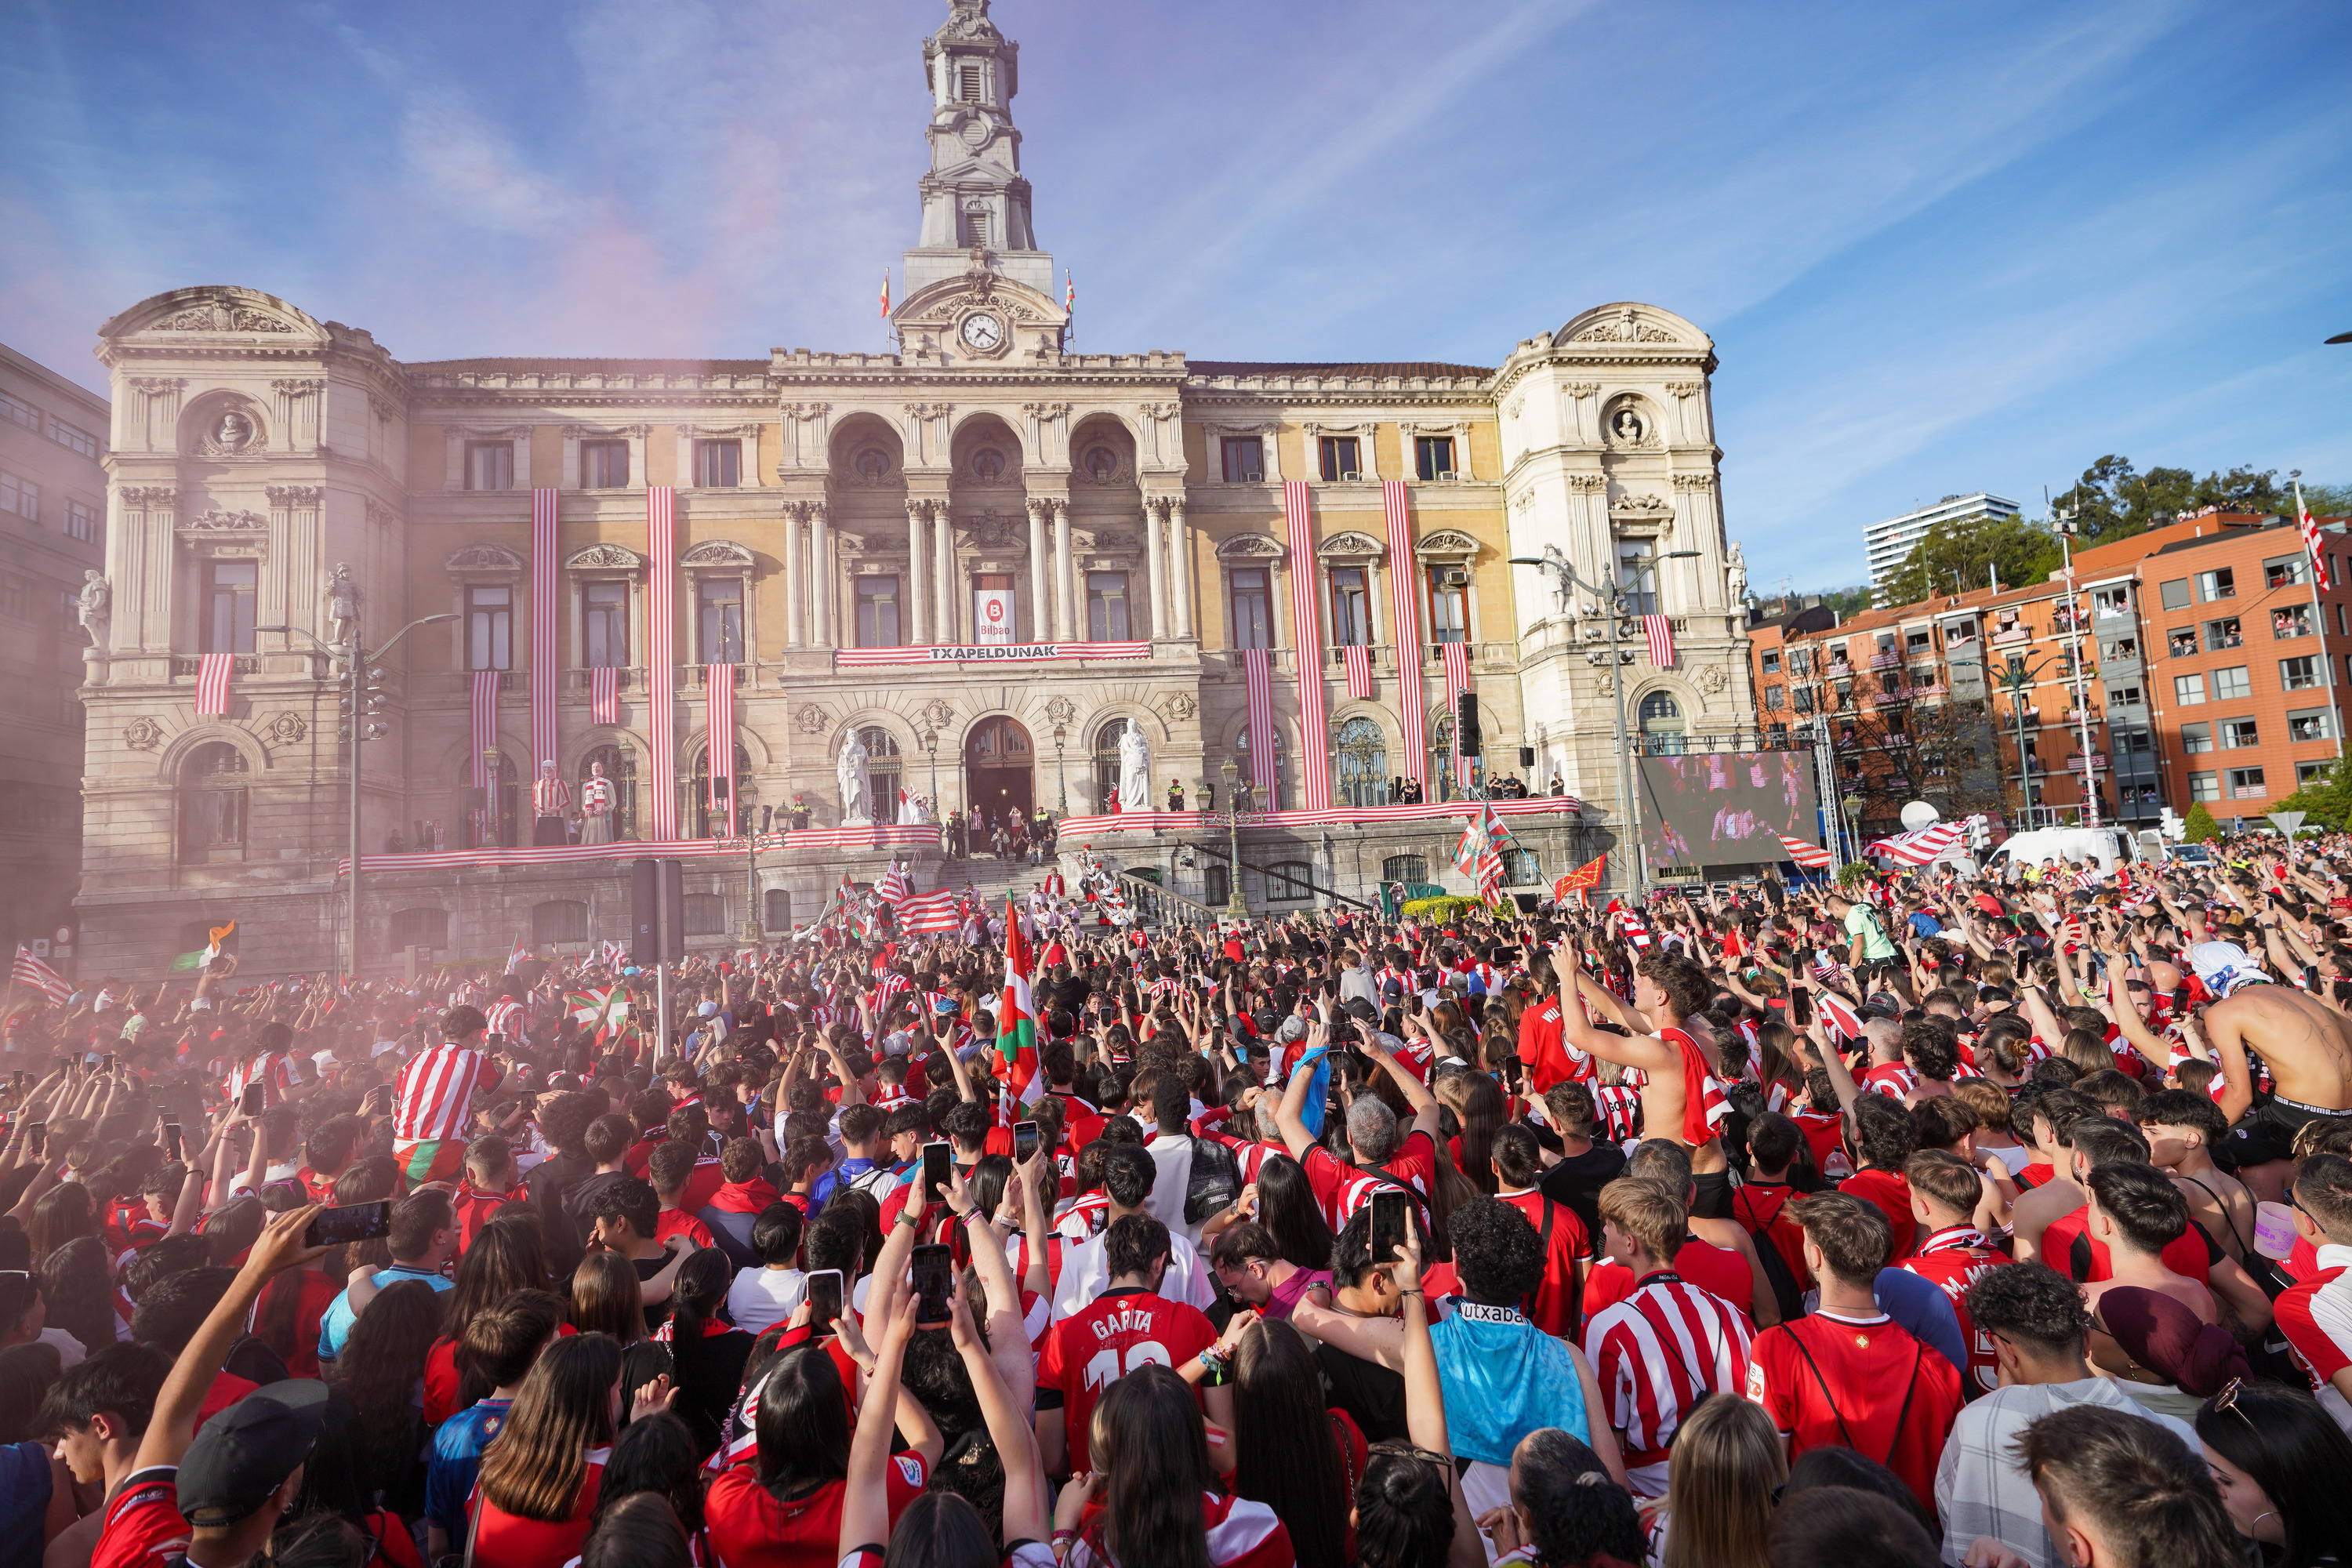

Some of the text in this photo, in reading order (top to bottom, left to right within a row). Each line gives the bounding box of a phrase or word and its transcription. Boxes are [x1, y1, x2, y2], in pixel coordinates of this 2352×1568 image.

[990, 604, 1000, 617] B
[981, 625, 1010, 635] Bilbao
[931, 645, 1058, 659] TXAPELDUNAK
[1541, 1005, 1561, 1024] WIL
[1607, 1098, 1636, 1112] GORK
[2303, 1104, 2331, 1116] PUMA
[1459, 1301, 1525, 1323] utxaba
[1091, 1308, 1152, 1341] GARITA
